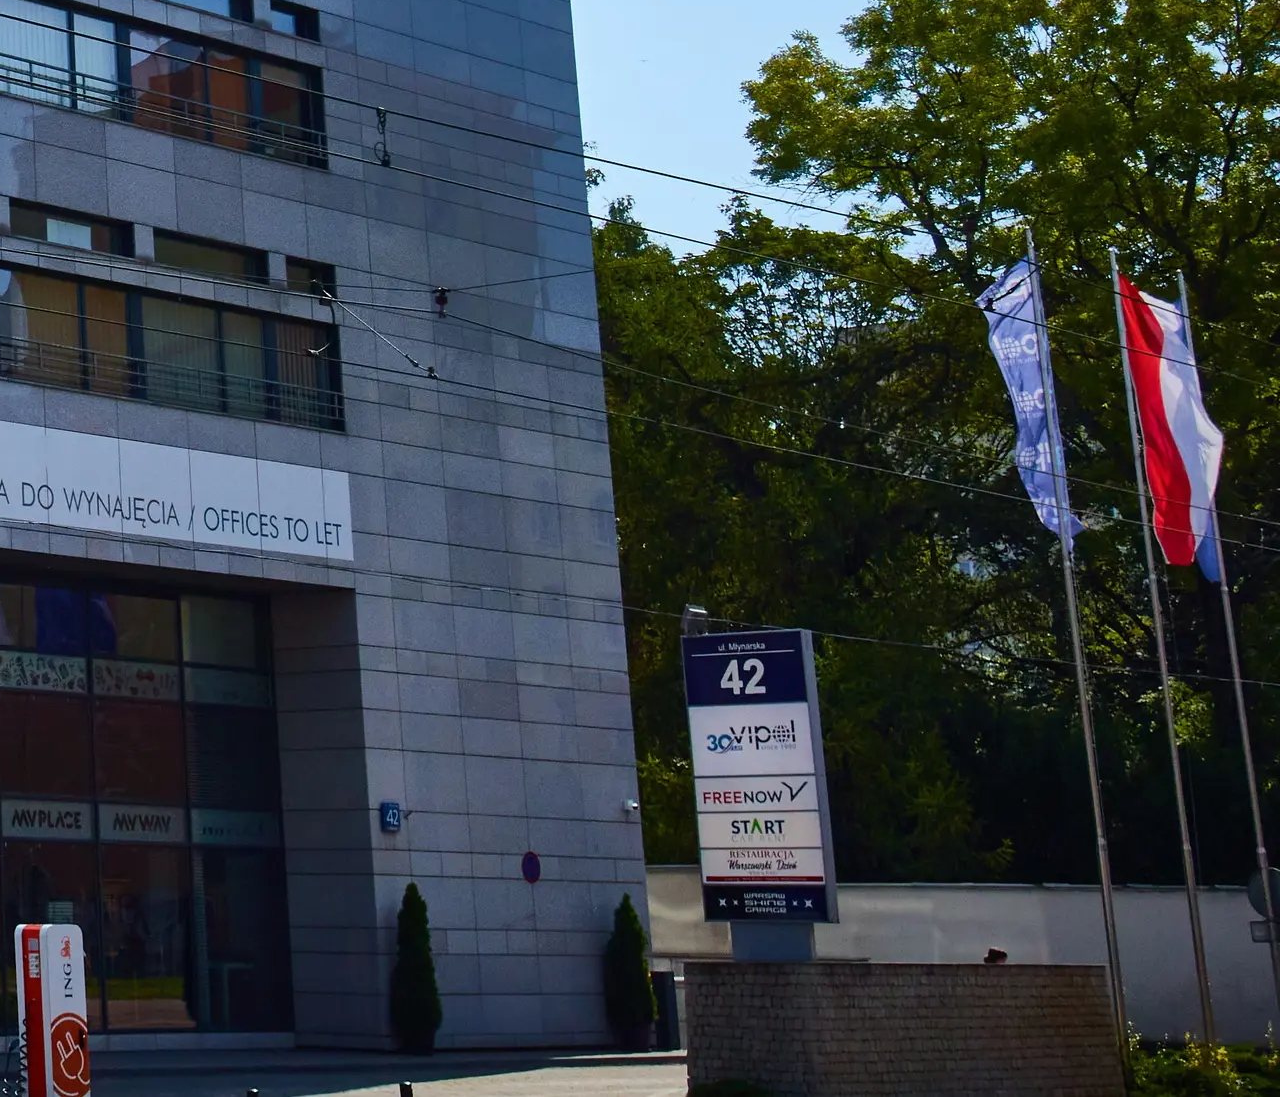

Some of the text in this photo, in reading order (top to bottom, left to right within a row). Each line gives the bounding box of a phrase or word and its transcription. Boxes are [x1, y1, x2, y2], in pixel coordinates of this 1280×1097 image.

[21, 482, 54, 510] DO
[63, 487, 180, 528] WYNAJĘCIA
[203, 507, 279, 539] OFFICES
[283, 516, 309, 542] TO
[315, 521, 342, 546] LET
[720, 658, 766, 695] 42
[706, 734, 733, 752] 30
[386, 809, 399, 825] 42
[731, 818, 785, 834] START
[729, 850, 794, 859] RESTAURACJA
[63, 963, 73, 998] ING
